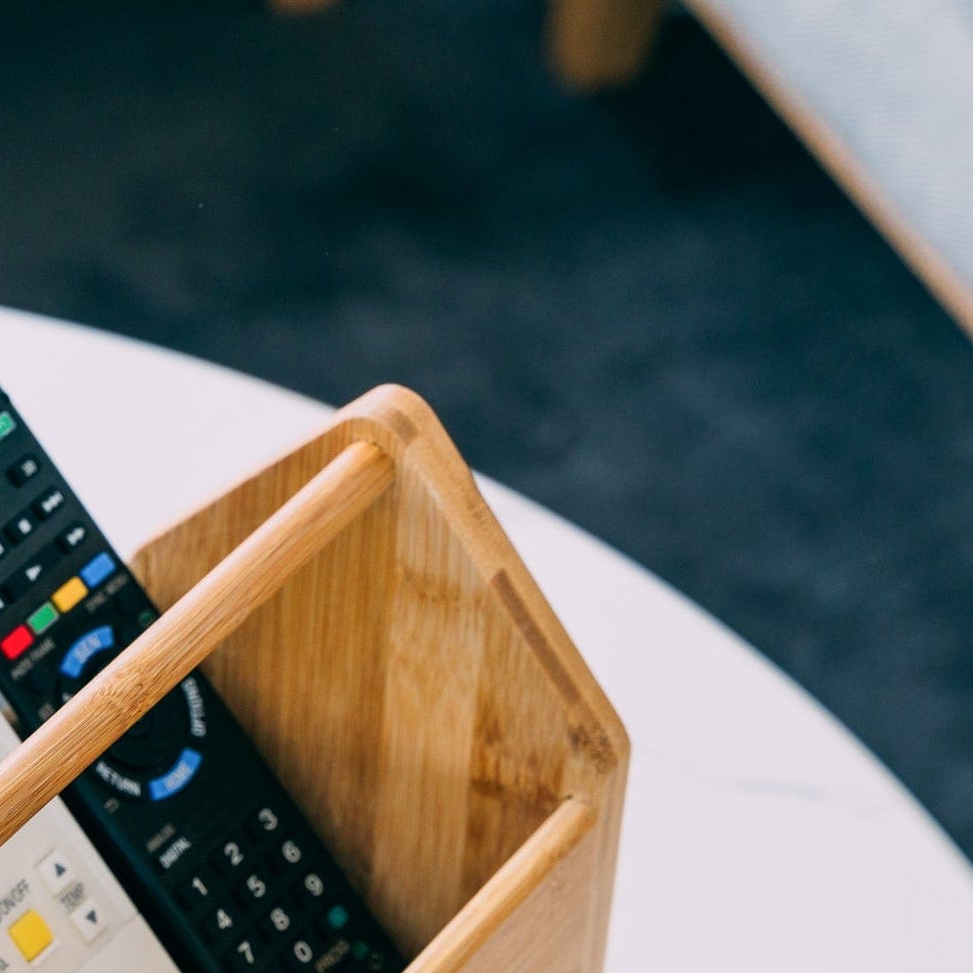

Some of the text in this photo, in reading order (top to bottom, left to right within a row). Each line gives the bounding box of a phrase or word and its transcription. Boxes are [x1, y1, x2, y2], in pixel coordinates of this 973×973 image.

[96, 761, 141, 796] RETURN
[258, 808, 278, 831] 3
[159, 837, 191, 869] DIGITAL
[224, 842, 244, 866] 2
[282, 840, 302, 863] 6
[61, 883, 85, 911] TEMP
[193, 877, 208, 896] 1
[246, 874, 266, 898] 5
[304, 873, 324, 897] 9
[217, 908, 233, 929] 4
[270, 907, 290, 931] 8
[237, 941, 255, 964] 7
[294, 940, 313, 963] 0
